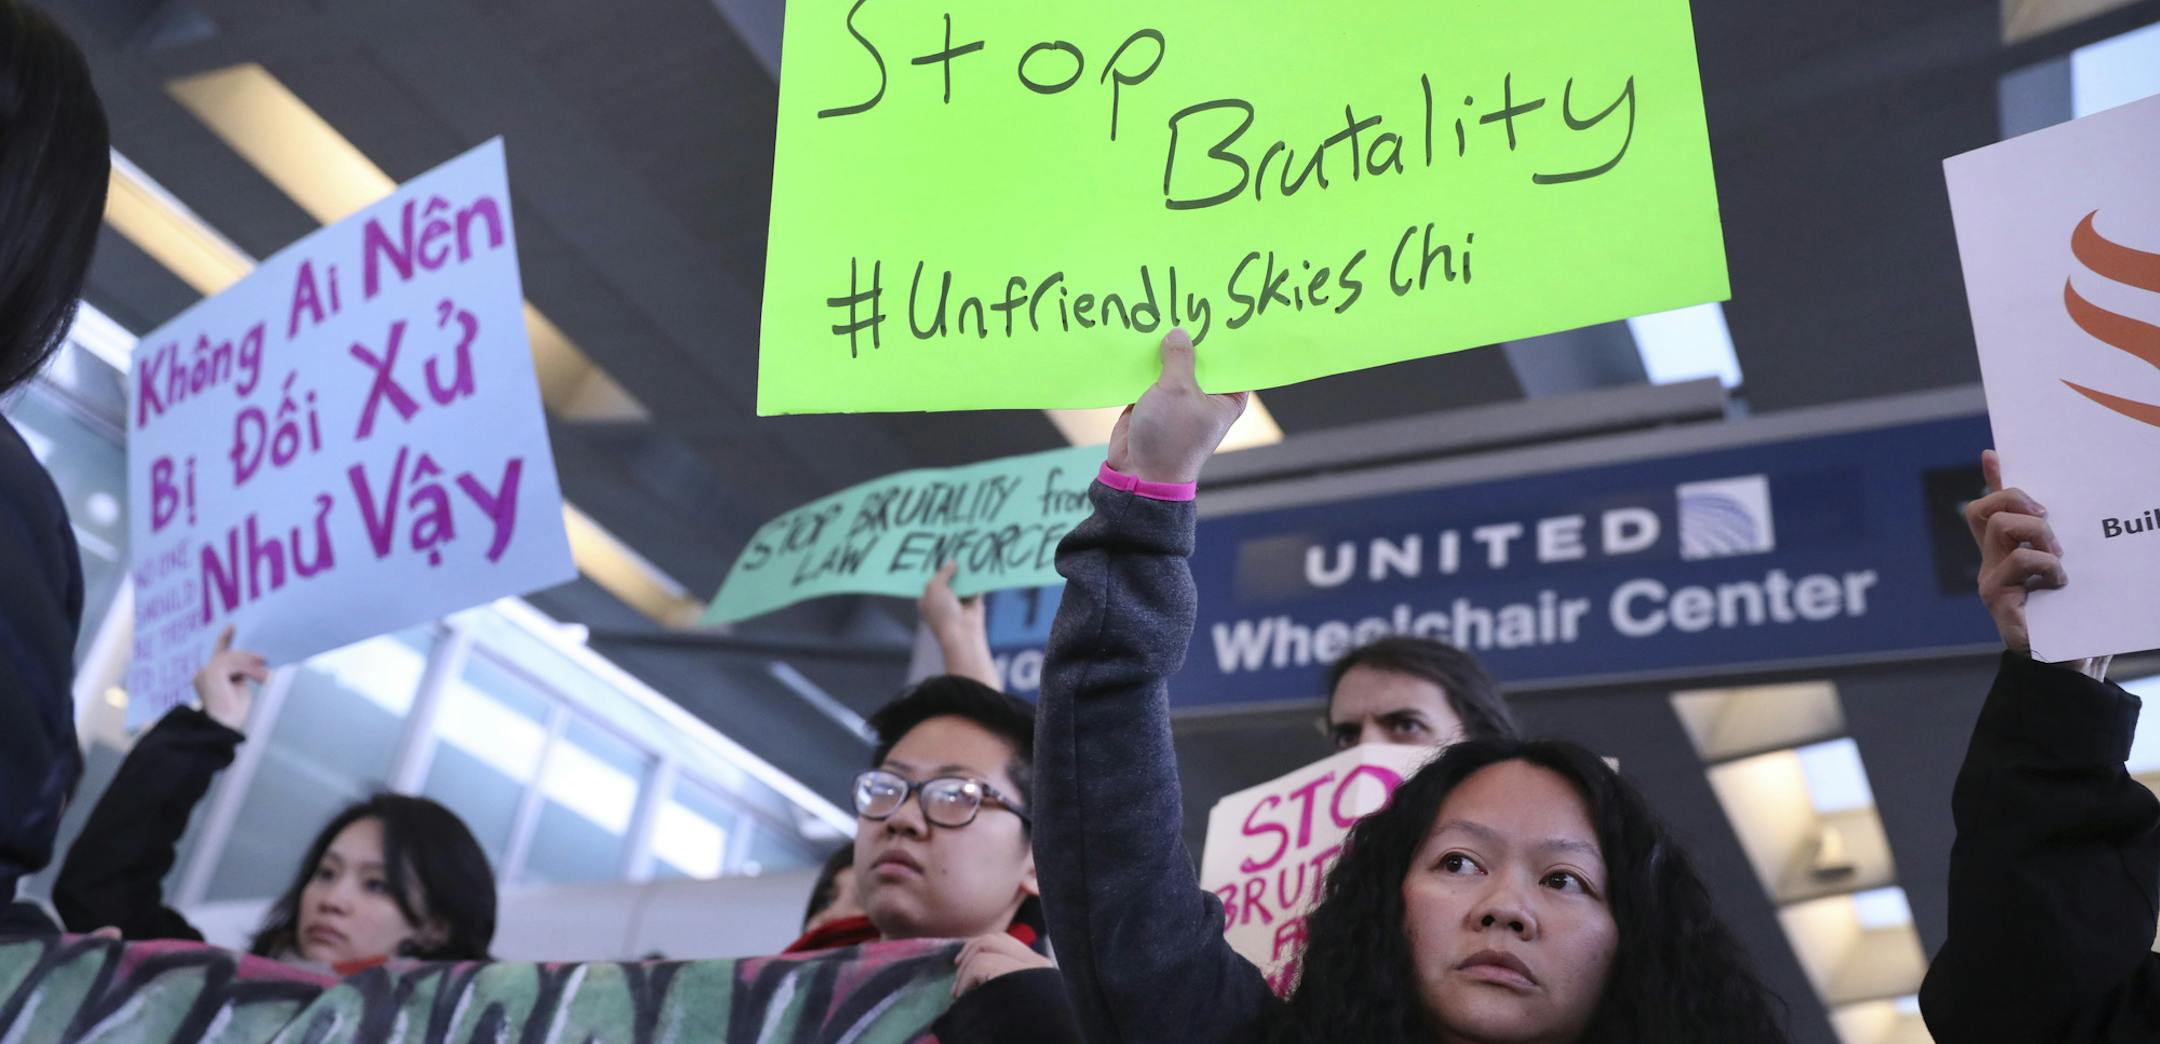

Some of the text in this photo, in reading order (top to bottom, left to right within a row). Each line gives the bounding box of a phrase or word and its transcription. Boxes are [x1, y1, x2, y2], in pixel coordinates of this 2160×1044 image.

[818, 0, 1166, 141] Stop
[1164, 74, 1636, 211] Brutality
[136, 194, 504, 430] Không Ai Nên
[149, 299, 479, 534] Bị Đối Xử
[200, 445, 525, 625] Như Vậy
[741, 503, 843, 572] STOP
[848, 474, 1023, 539] BRUTALITY
[791, 535, 880, 587] LAW
[1304, 508, 1661, 587] UNITED
[1609, 568, 1879, 638] Center
